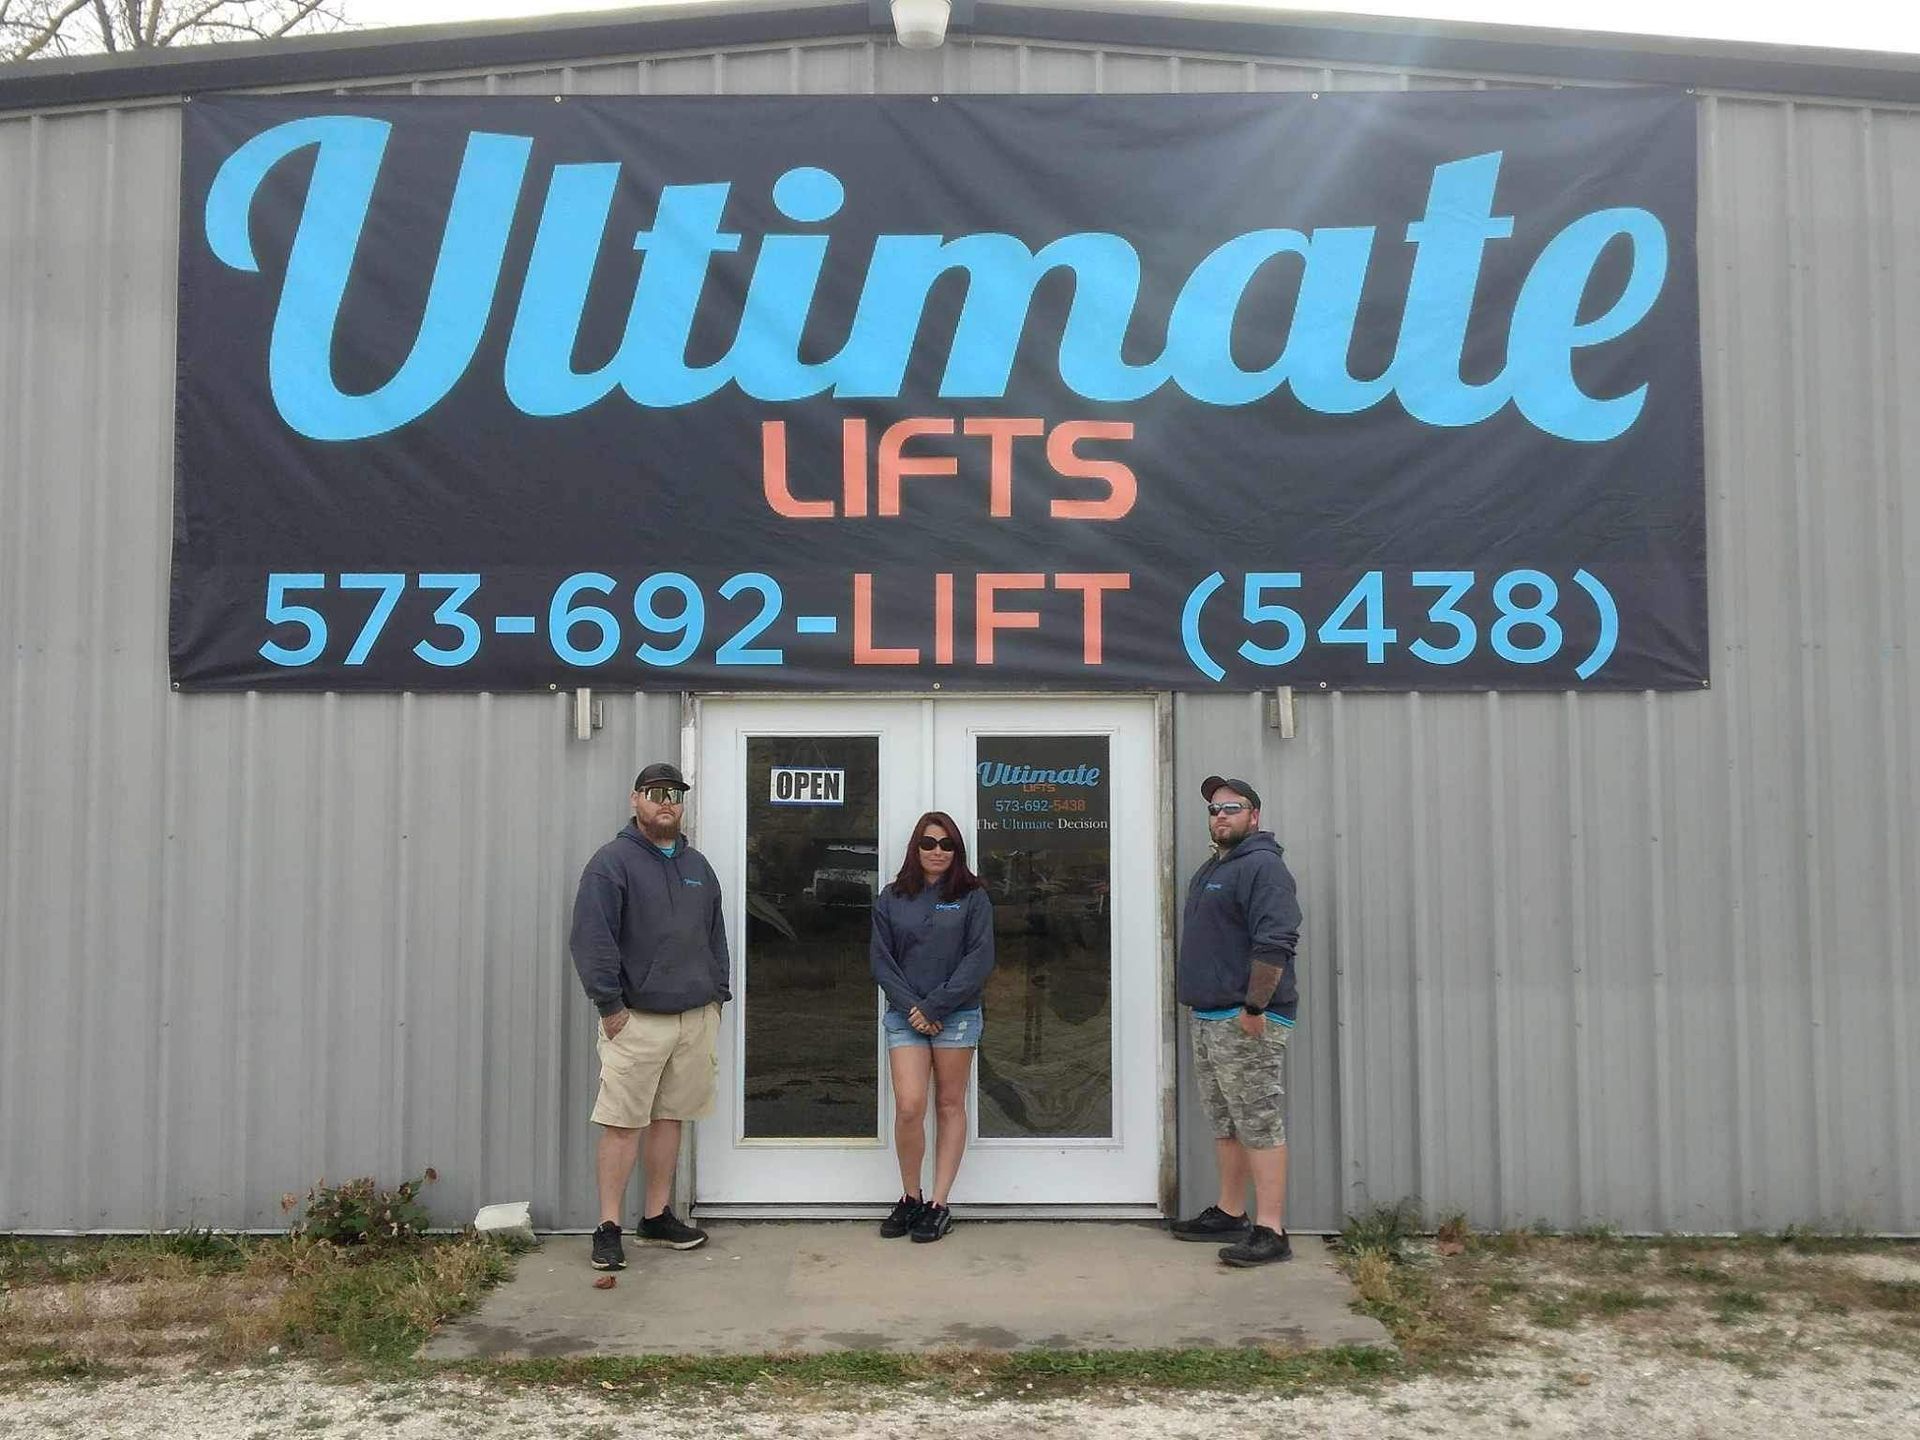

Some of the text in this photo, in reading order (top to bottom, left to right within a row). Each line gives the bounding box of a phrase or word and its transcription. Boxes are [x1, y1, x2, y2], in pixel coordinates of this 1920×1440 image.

[205, 115, 1670, 442] Ultimate
[763, 417, 1137, 520] LIFTS
[259, 569, 1619, 683] 573-692-LIFT (5438)
[775, 771, 840, 800] OPEN
[977, 761, 1101, 787] Ultimate
[1023, 784, 1056, 793] LIFTS
[995, 800, 1086, 812] 573-692-5438
[1003, 818, 1054, 830] Ultimate
[1058, 818, 1108, 829] Decision
